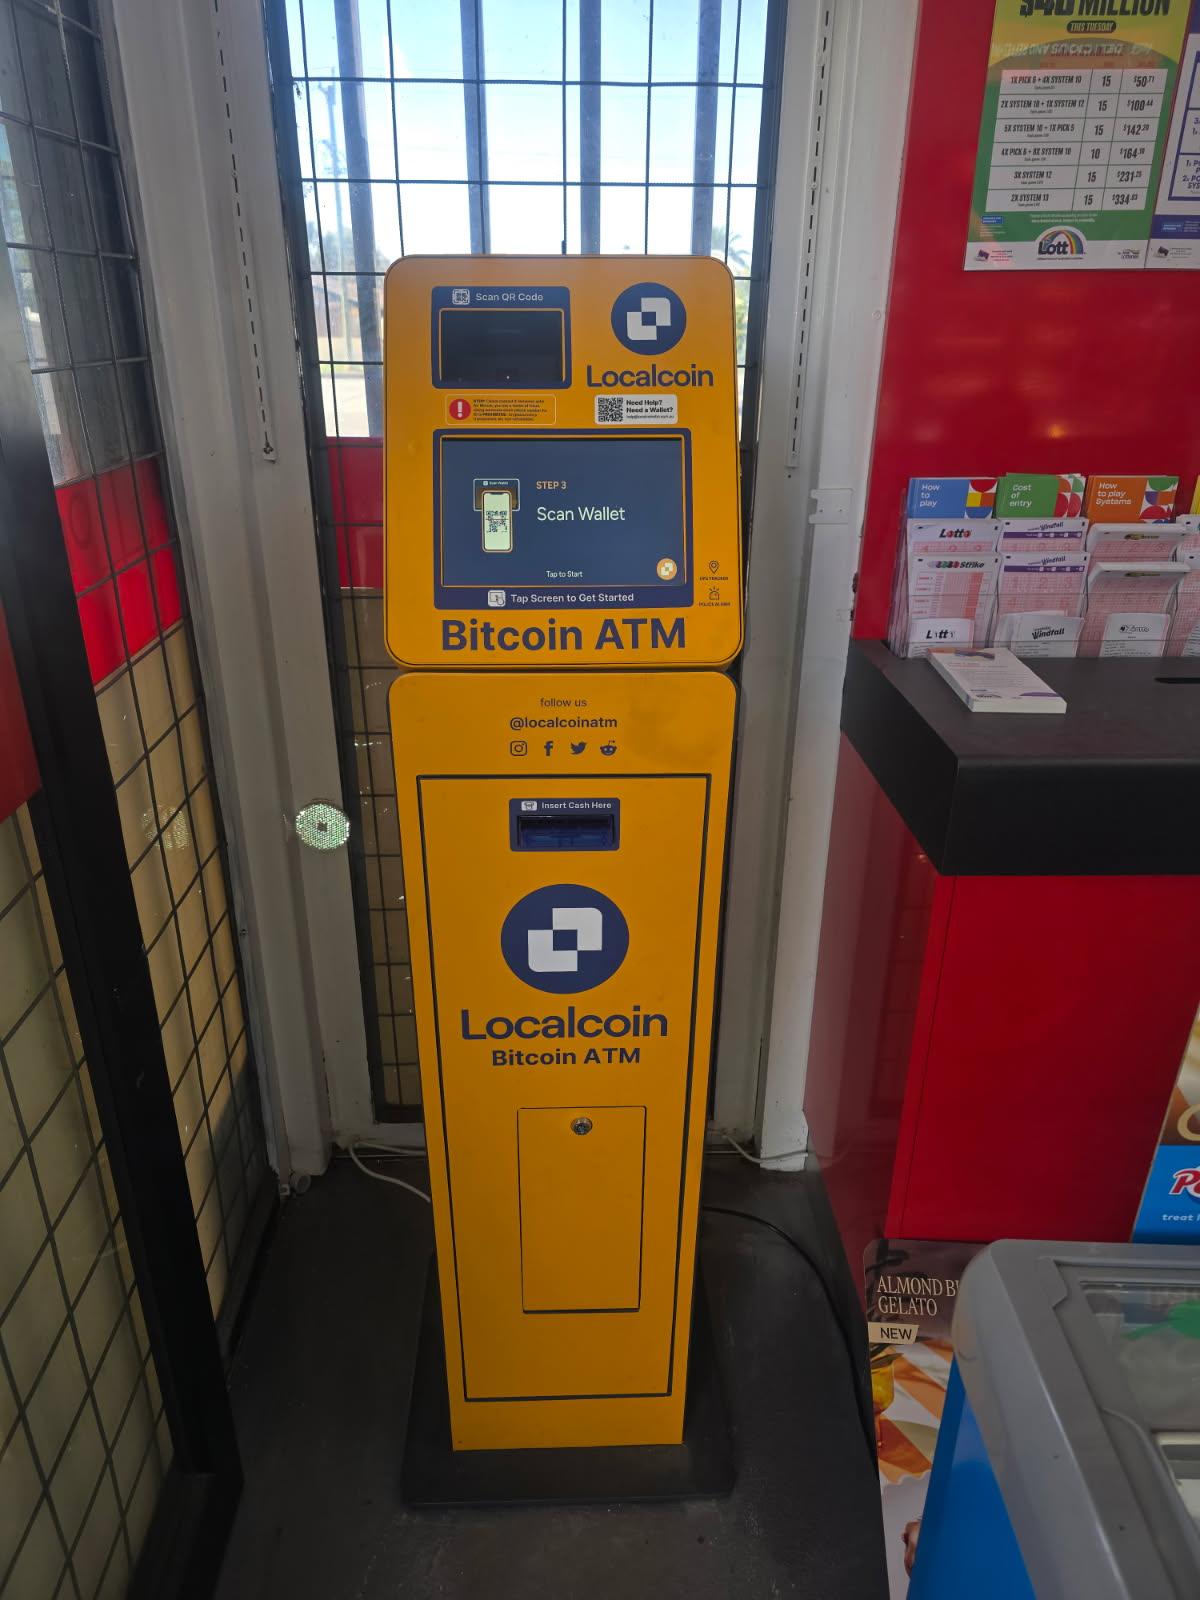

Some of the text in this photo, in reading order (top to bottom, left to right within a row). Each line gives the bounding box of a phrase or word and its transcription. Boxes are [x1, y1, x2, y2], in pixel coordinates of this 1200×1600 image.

[1101, 75, 1112, 87] 15
[1009, 100, 1032, 108] SYSTEM
[1054, 99, 1078, 108] SYSTEM
[1098, 100, 1107, 111] 15
[1012, 124, 1036, 132] SYSTEM
[1094, 124, 1104, 136] 15
[1090, 148, 1100, 160] 10
[1021, 171, 1045, 179] SYSTEM
[1087, 171, 1097, 183] 15
[1019, 194, 1042, 202] SYSTEM
[1083, 194, 1093, 206] 15
[475, 292, 543, 302] Scan QR Code
[586, 363, 714, 387] Localcoin
[644, 399, 663, 407] Help?
[536, 480, 567, 490] STEP 3
[921, 483, 940, 491] How
[1012, 483, 1032, 492] Cost
[1107, 490, 1127, 499] play
[919, 499, 938, 508] play
[1009, 500, 1032, 508] entry
[536, 506, 626, 521] Scan Wallet
[939, 528, 972, 539] Lotto
[959, 560, 985, 569] Strike
[546, 570, 558, 579] Tap
[567, 570, 583, 578] Start
[510, 592, 634, 604] Tap Screen to Get Started
[442, 617, 686, 651] Bitcoin ATM
[1031, 627, 1065, 640] Windfall
[540, 697, 588, 707] follow us
[509, 716, 618, 731] @localcoinatm
[541, 801, 612, 809] Insert Cash Here
[460, 1005, 668, 1040] Localcoin
[492, 1047, 641, 1066] Bitcoin ATM
[1162, 1213, 1194, 1221] treat
[877, 1275, 943, 1296] ALMOND
[877, 1295, 938, 1316] GELATO
[880, 1327, 912, 1340] NEW
